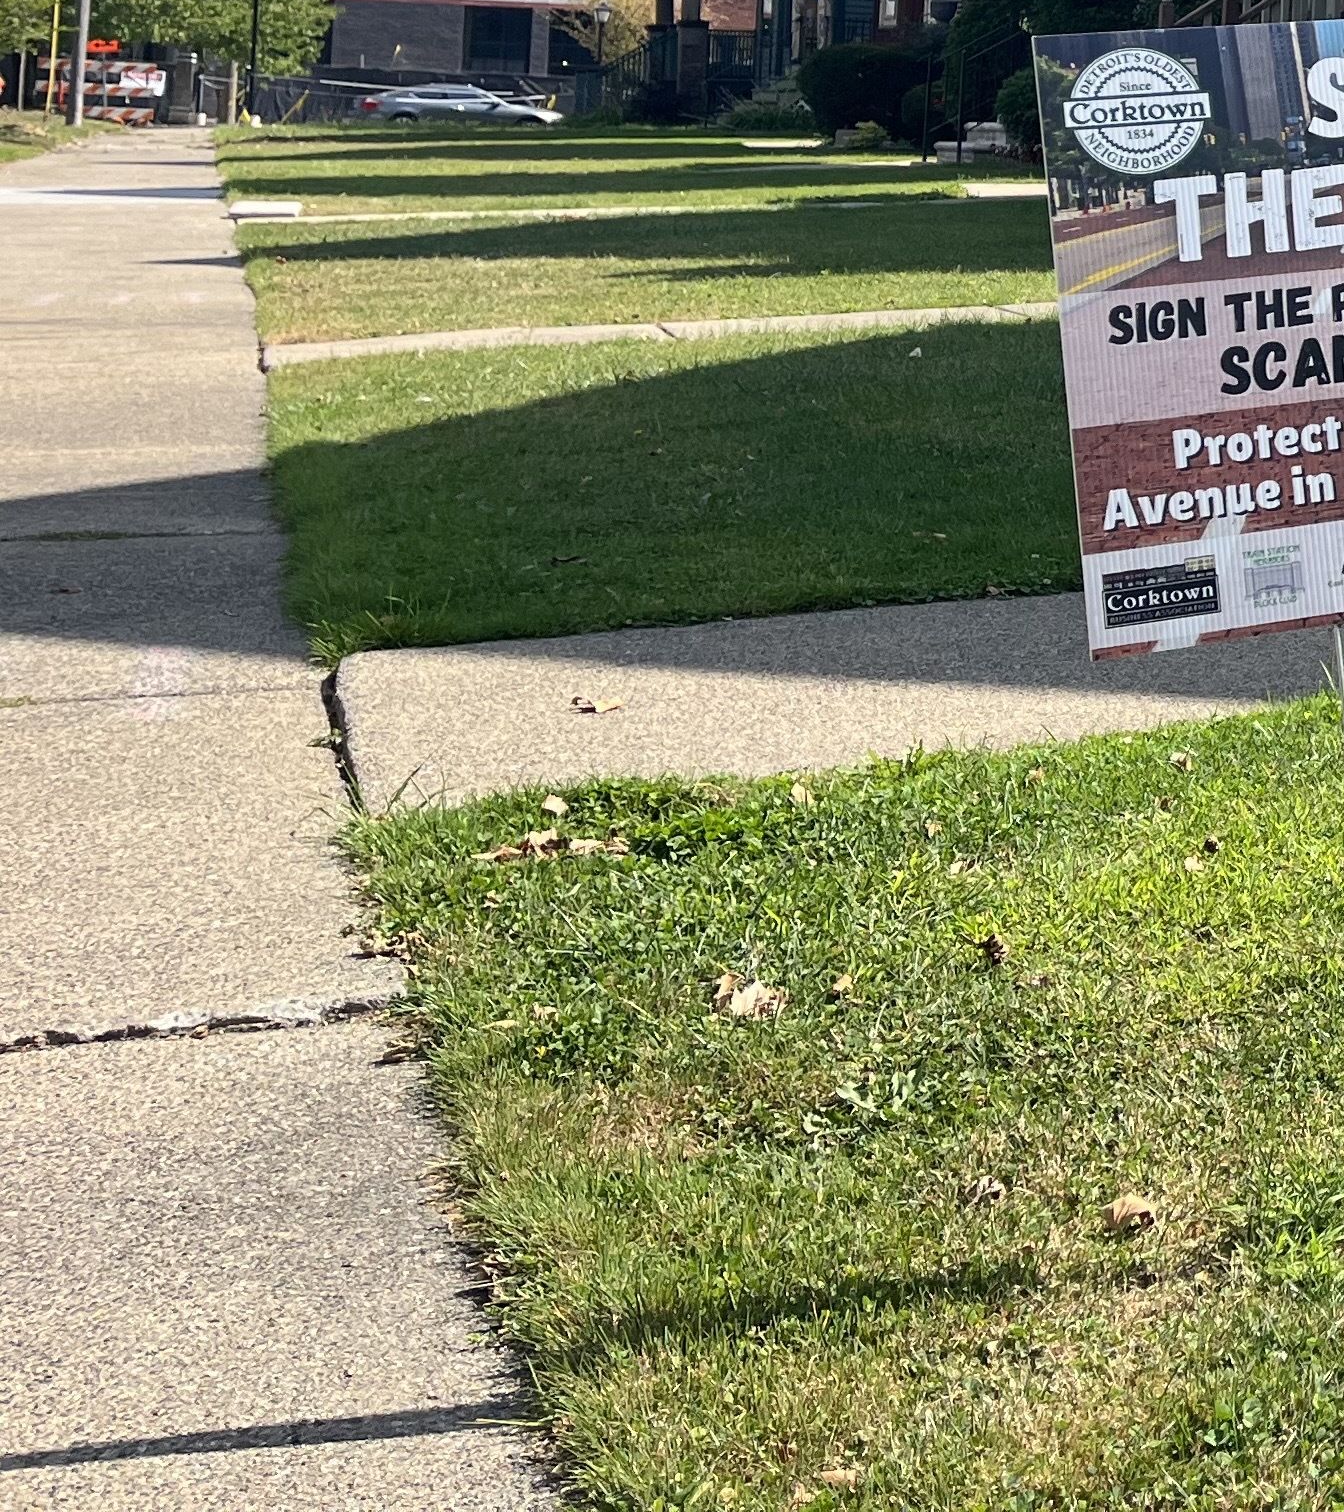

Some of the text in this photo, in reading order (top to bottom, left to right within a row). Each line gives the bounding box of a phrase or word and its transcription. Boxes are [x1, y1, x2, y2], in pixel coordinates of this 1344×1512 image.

[1079, 52, 1193, 96] DETROIT'S OLDEST
[1119, 80, 1152, 93] Since
[1069, 100, 1206, 125] Corktown
[1127, 128, 1155, 140] 1834
[1085, 126, 1195, 170] NEIGHBORHOOD
[1107, 296, 1208, 346] SIGN
[1223, 285, 1313, 333] THE
[1172, 415, 1342, 469] Protect
[1103, 478, 1281, 531] Avenue
[1291, 464, 1336, 506] in
[1107, 584, 1214, 611] Corktown
